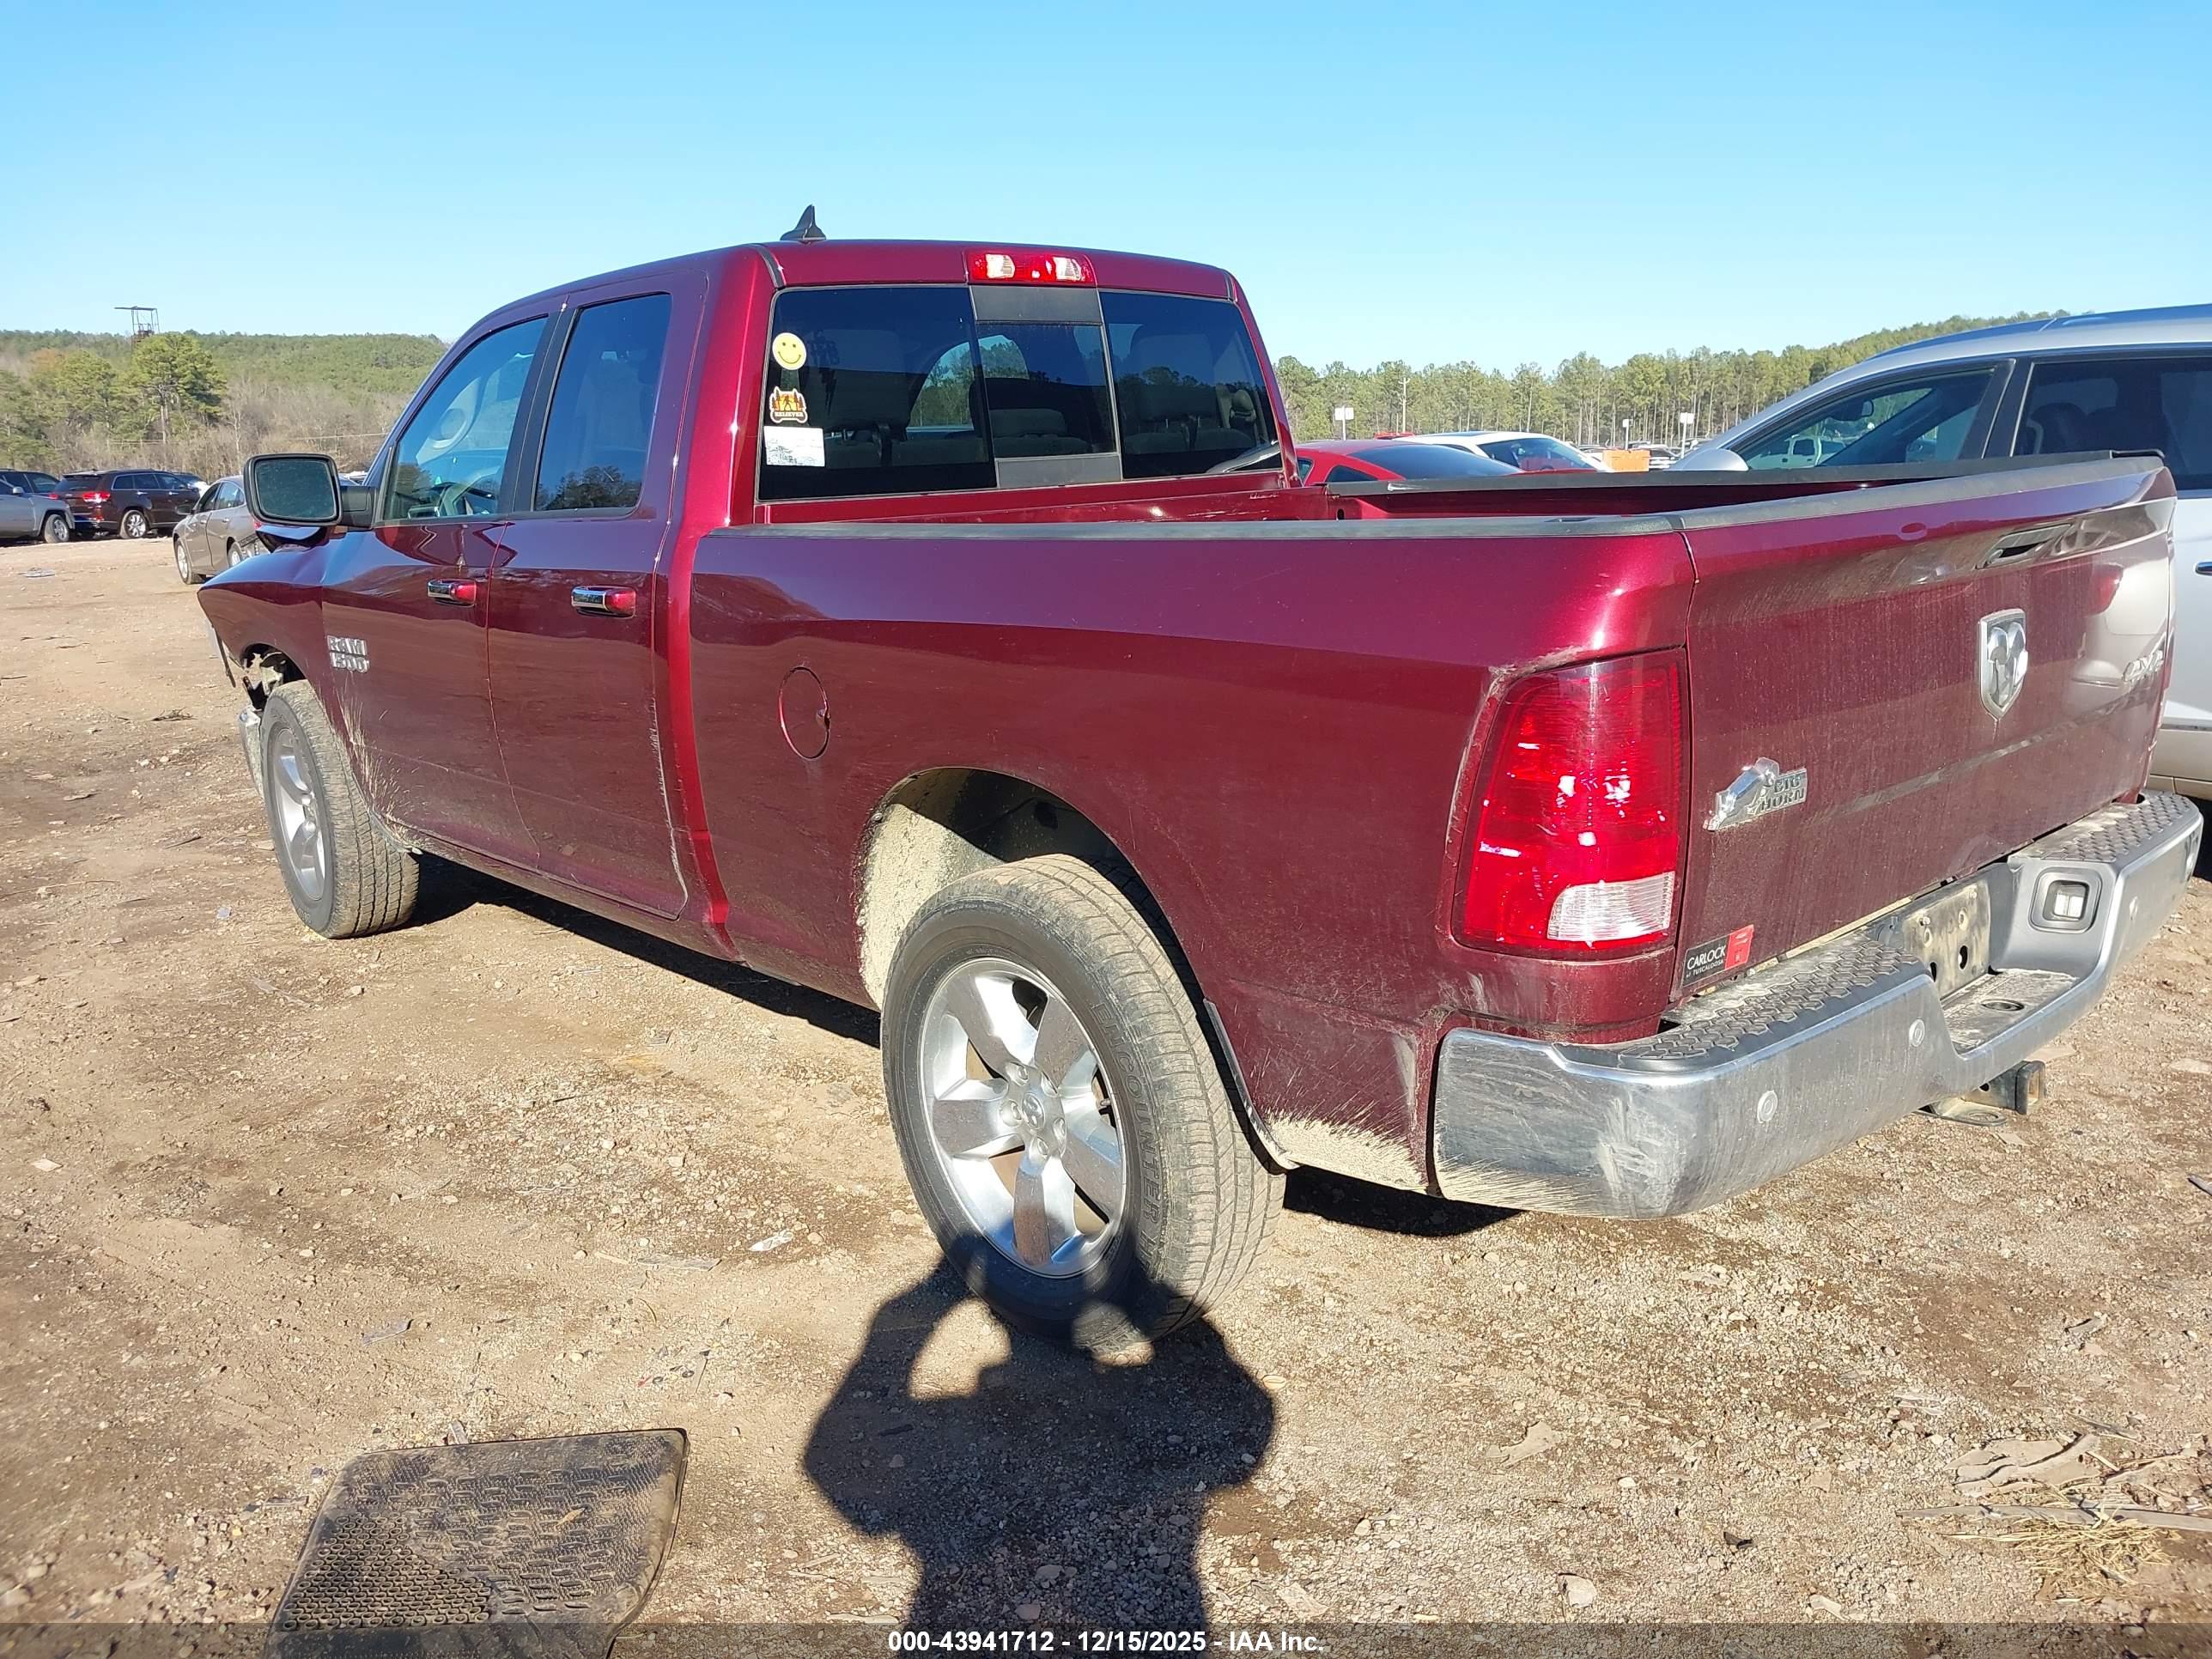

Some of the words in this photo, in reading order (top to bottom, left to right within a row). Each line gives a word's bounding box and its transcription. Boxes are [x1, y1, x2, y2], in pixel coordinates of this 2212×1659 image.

[327, 635, 368, 656] RAM
[1760, 788, 1804, 811] HORN
[1686, 945, 1726, 970] CARLOCK
[1692, 959, 1724, 976] TUSCALOOSA
